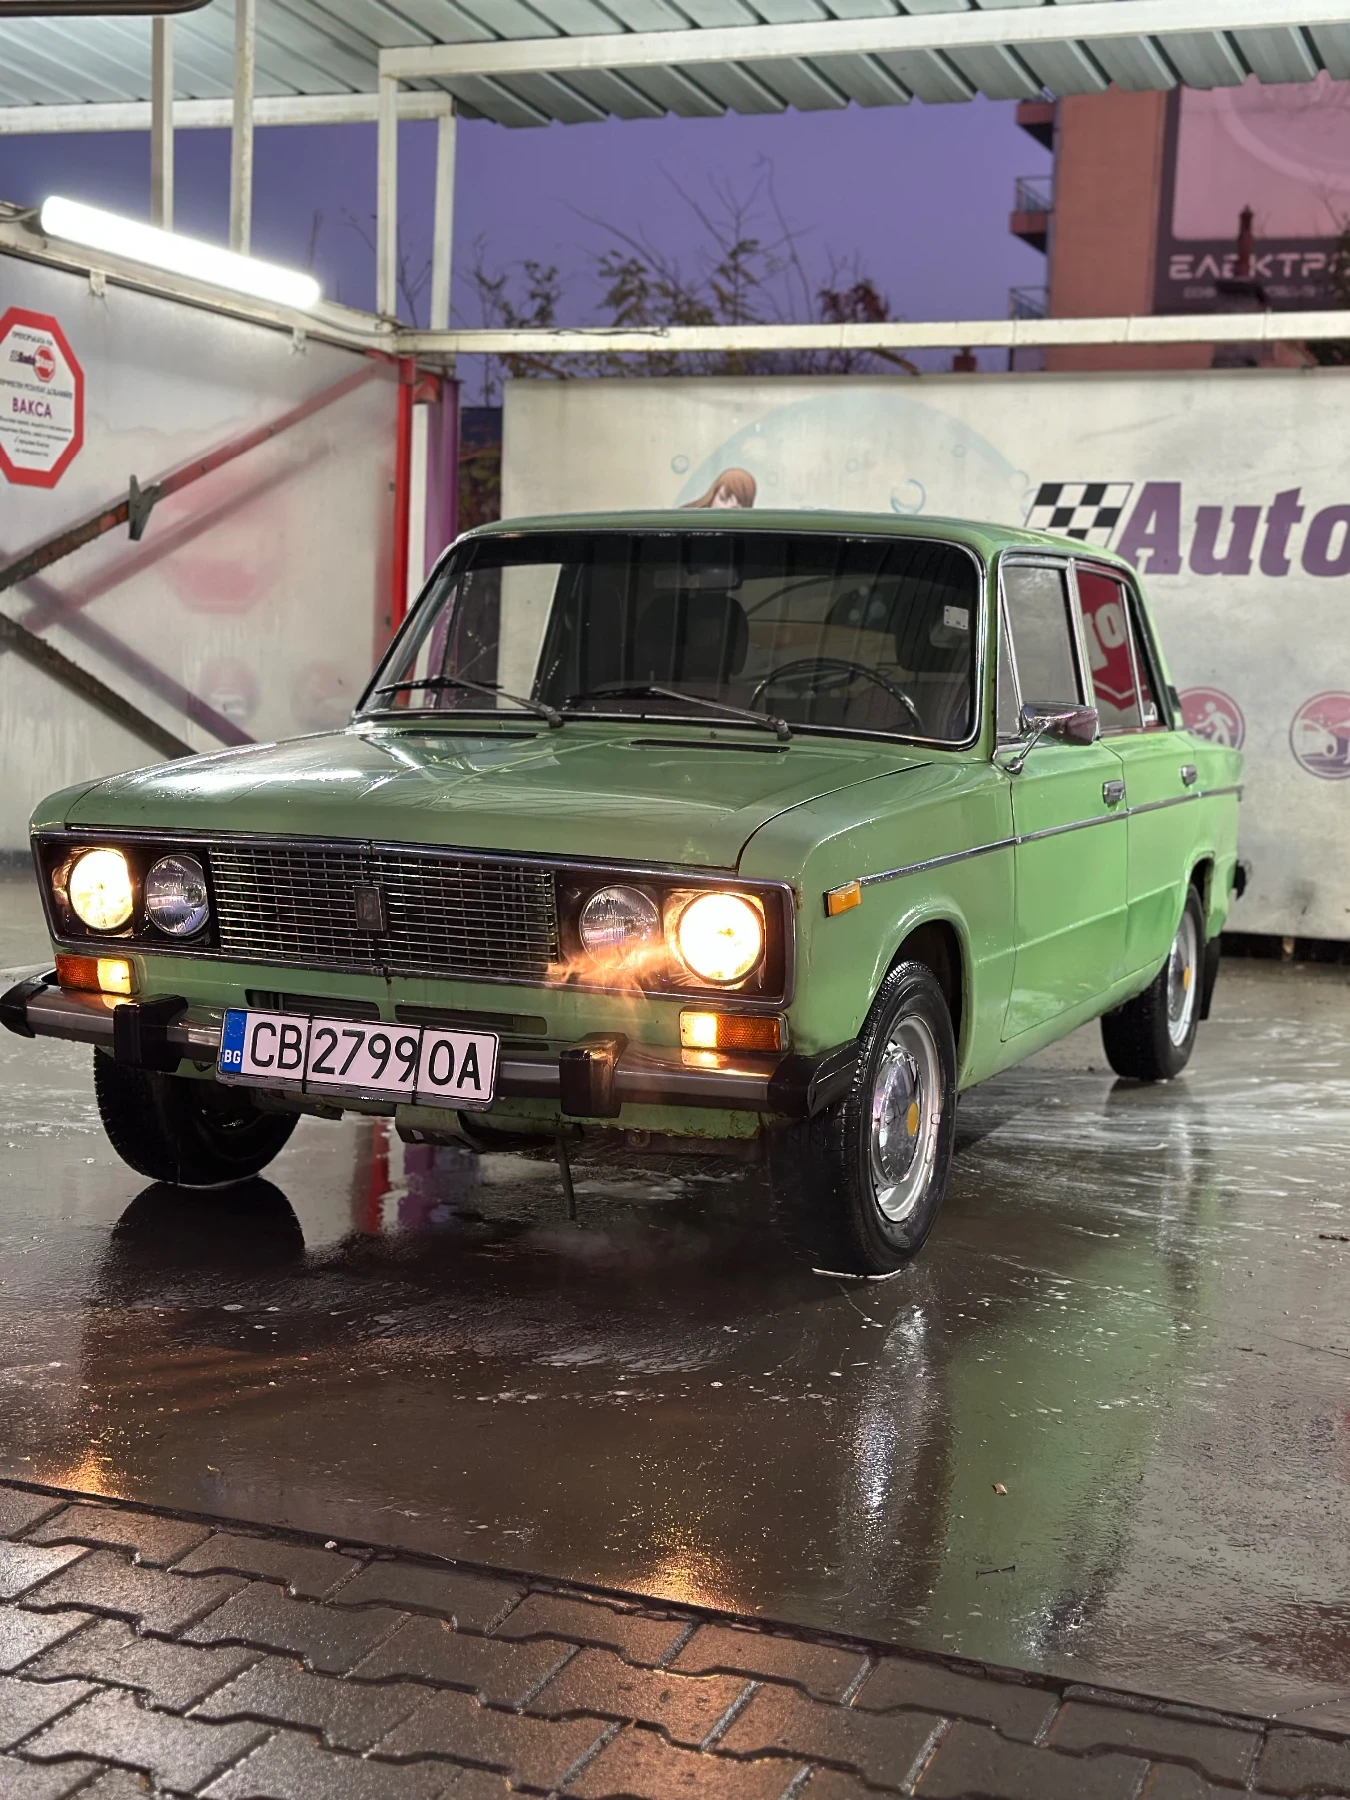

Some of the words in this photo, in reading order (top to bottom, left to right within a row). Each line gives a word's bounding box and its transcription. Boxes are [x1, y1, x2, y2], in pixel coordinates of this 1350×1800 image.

[1169, 252, 1350, 280] ЕЛЕКТР
[12, 396, 52, 419] ВАКСА
[1114, 481, 1350, 578] Auto
[223, 1049, 241, 1064] BG
[250, 1022, 302, 1070] CB
[311, 1027, 418, 1083] 2799
[428, 1039, 482, 1091] OA
